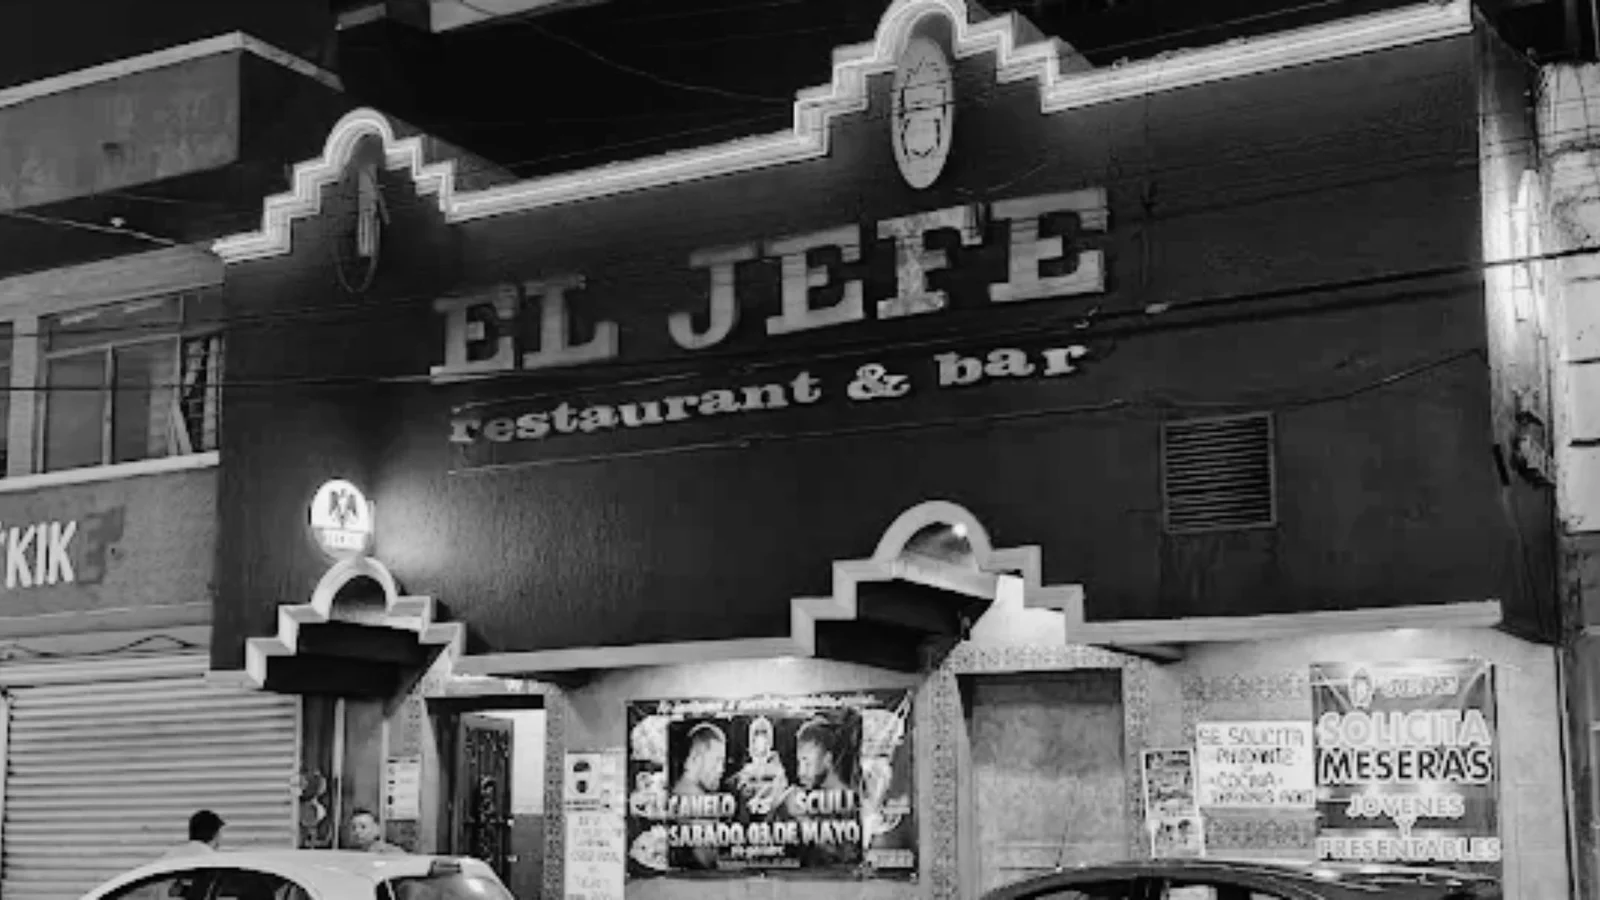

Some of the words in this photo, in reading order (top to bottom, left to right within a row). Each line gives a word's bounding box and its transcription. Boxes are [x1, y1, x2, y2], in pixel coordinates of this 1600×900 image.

[431, 273, 619, 384] EL
[668, 188, 1107, 350] JEFE
[449, 371, 821, 444] restaurant
[846, 363, 910, 399] &
[936, 344, 1088, 387] bar
[1318, 710, 1492, 748] SOLICITA
[1320, 750, 1492, 782] MESERAS
[1346, 795, 1465, 817] JOVENES
[802, 818, 860, 844] MAYO
[1316, 837, 1501, 861] PRESENTABLES
